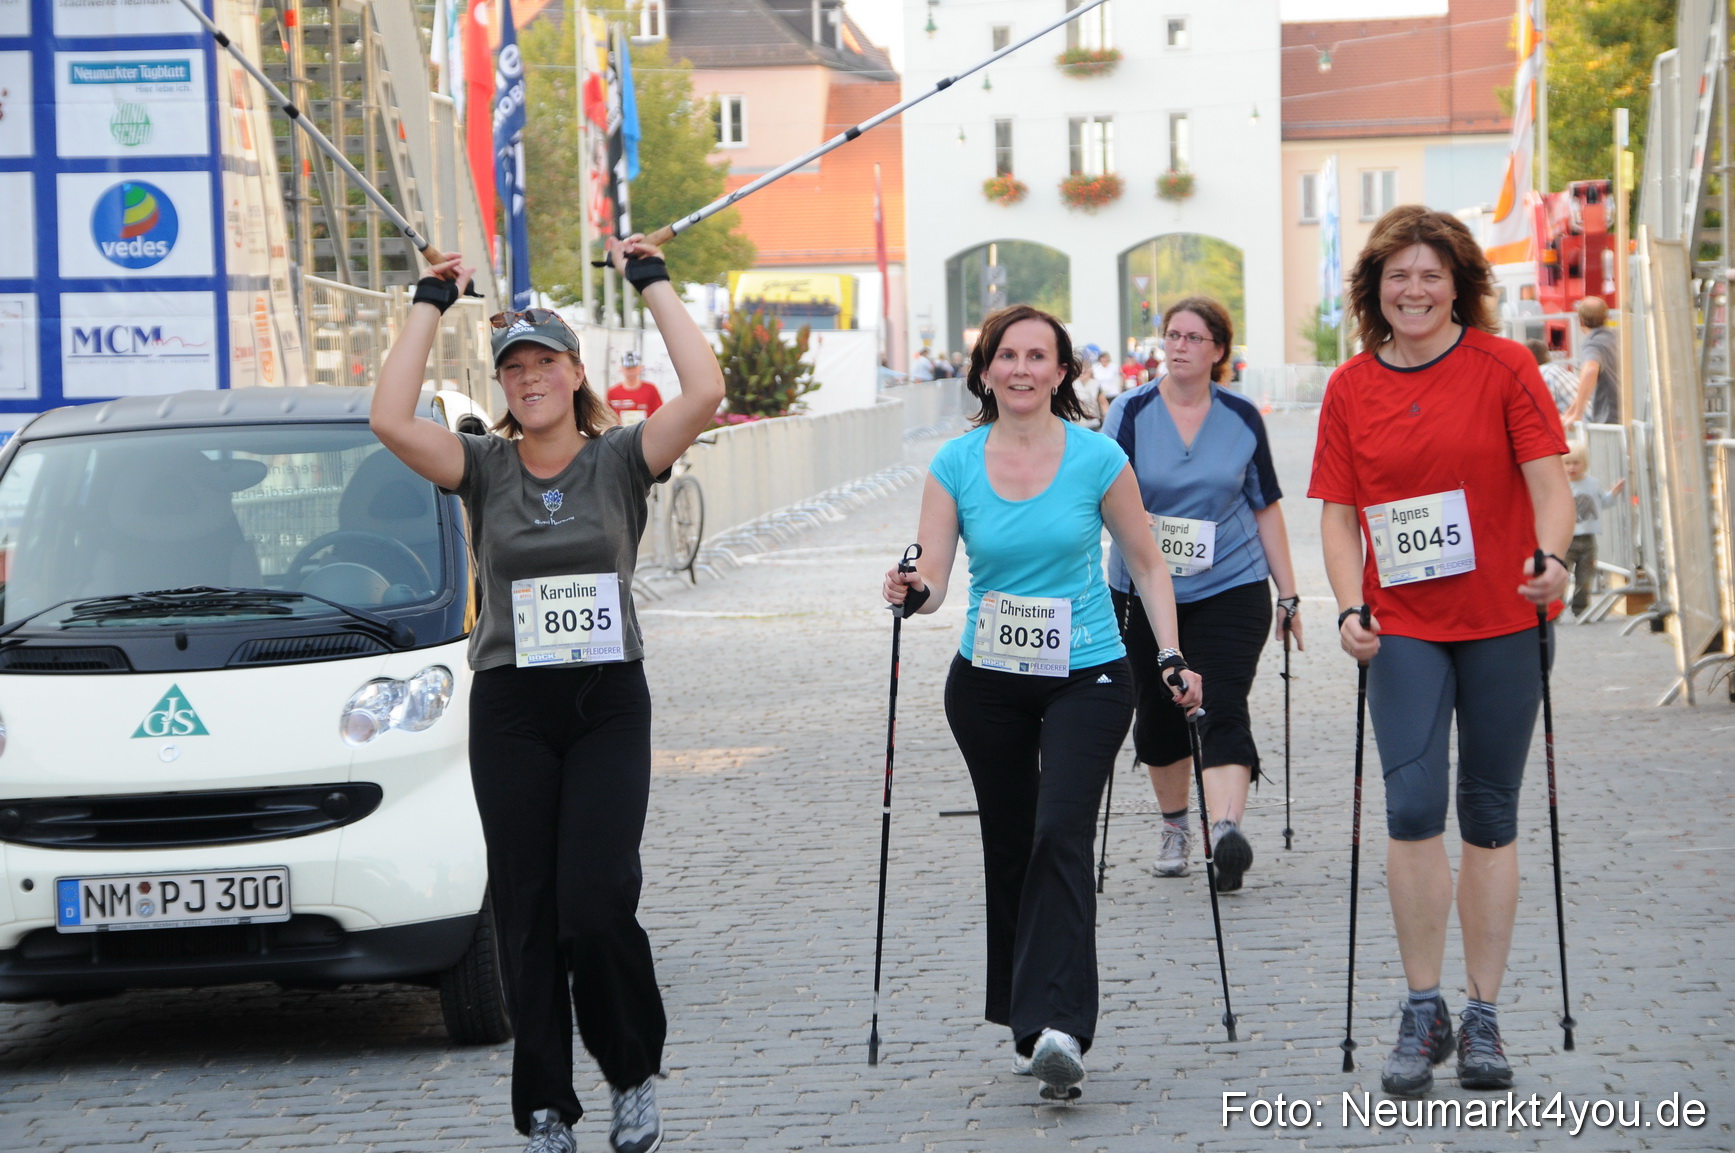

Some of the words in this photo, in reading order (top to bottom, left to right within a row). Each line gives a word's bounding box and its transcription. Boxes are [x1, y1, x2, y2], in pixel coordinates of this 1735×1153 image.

[73, 66, 137, 80] Neumarkter
[138, 64, 186, 79] Tagblatt
[135, 85, 152, 93] Hier
[156, 84, 174, 92] lebe
[101, 235, 168, 258] vedes
[70, 325, 162, 354] MCM
[507, 326, 536, 339] adidas
[1391, 507, 1430, 525] Agnes
[1161, 521, 1190, 535] Ingrid
[1374, 535, 1382, 547] N
[1397, 523, 1462, 554] 8045
[1161, 538, 1207, 559] 8032
[540, 582, 597, 600] Karoline
[1000, 599, 1056, 619] Christine
[518, 612, 525, 625] N
[544, 607, 612, 634] 8035
[979, 618, 986, 630] N
[999, 624, 1061, 650] 8036
[582, 646, 622, 656] PFLEIDERER
[1030, 661, 1068, 673] PFLEIDERER
[84, 883, 132, 918] NM
[159, 880, 206, 914] PJ
[216, 875, 284, 911] 300
[65, 908, 75, 918] D
